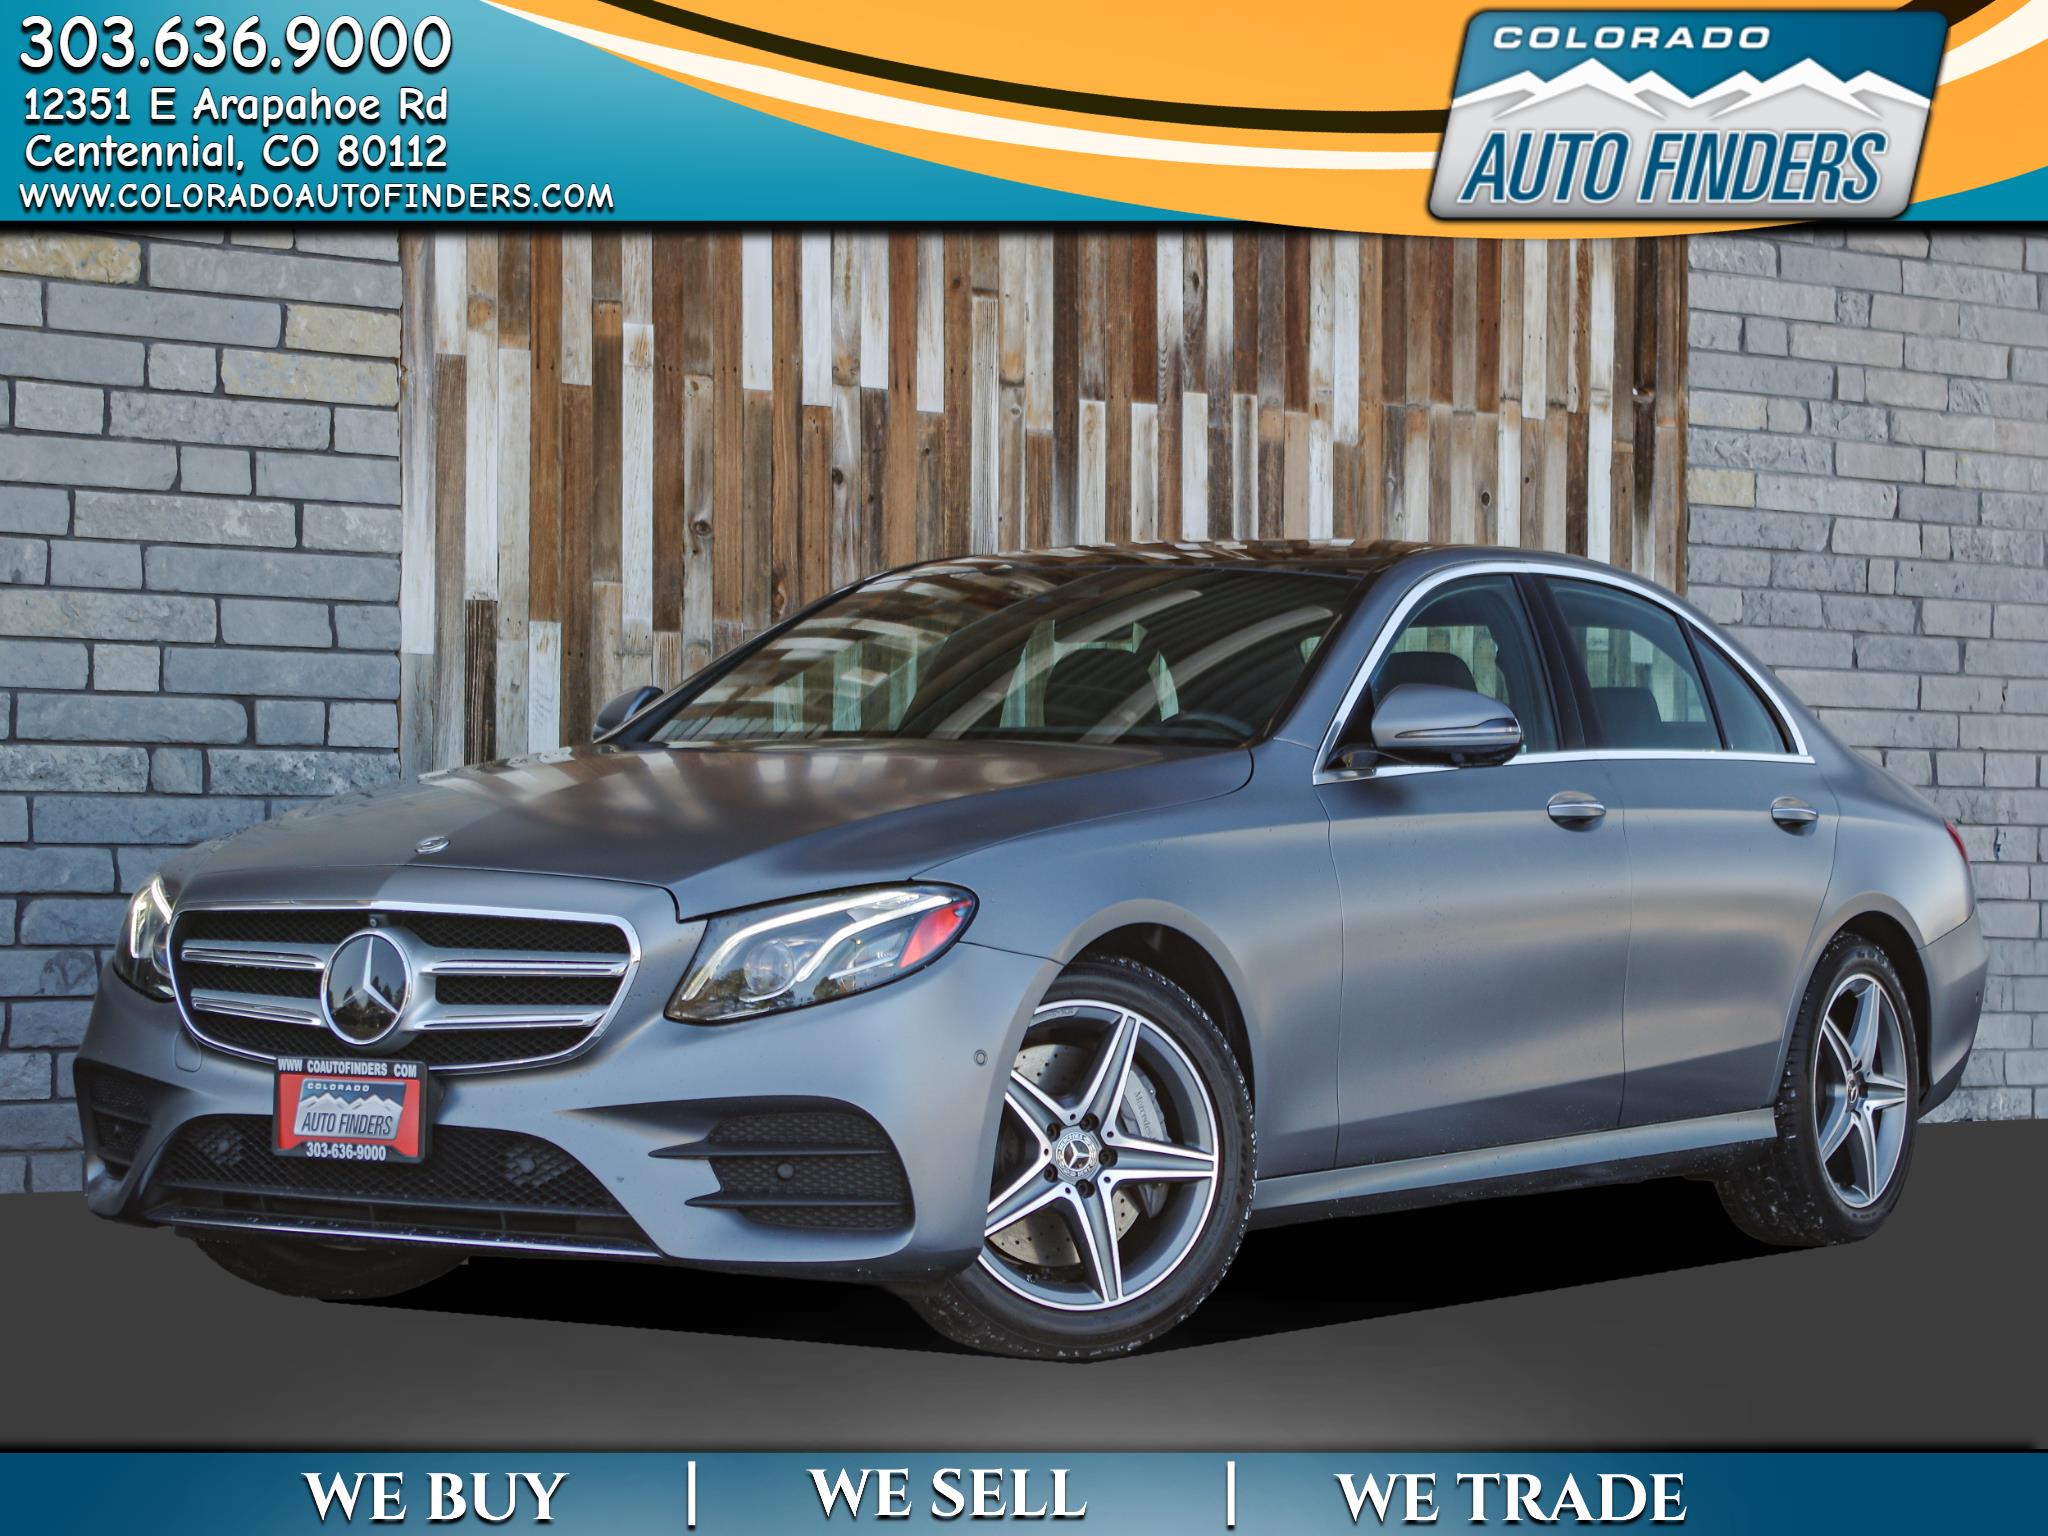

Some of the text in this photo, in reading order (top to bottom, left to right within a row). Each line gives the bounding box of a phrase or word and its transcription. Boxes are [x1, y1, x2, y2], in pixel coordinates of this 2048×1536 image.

[307, 1060, 387, 1076] COAUTOFINDERS
[393, 1064, 417, 1077] COM
[307, 1082, 370, 1092] COLORADO
[301, 1111, 393, 1135] AUTO FINDERS
[306, 1142, 386, 1161] 303-636-9000
